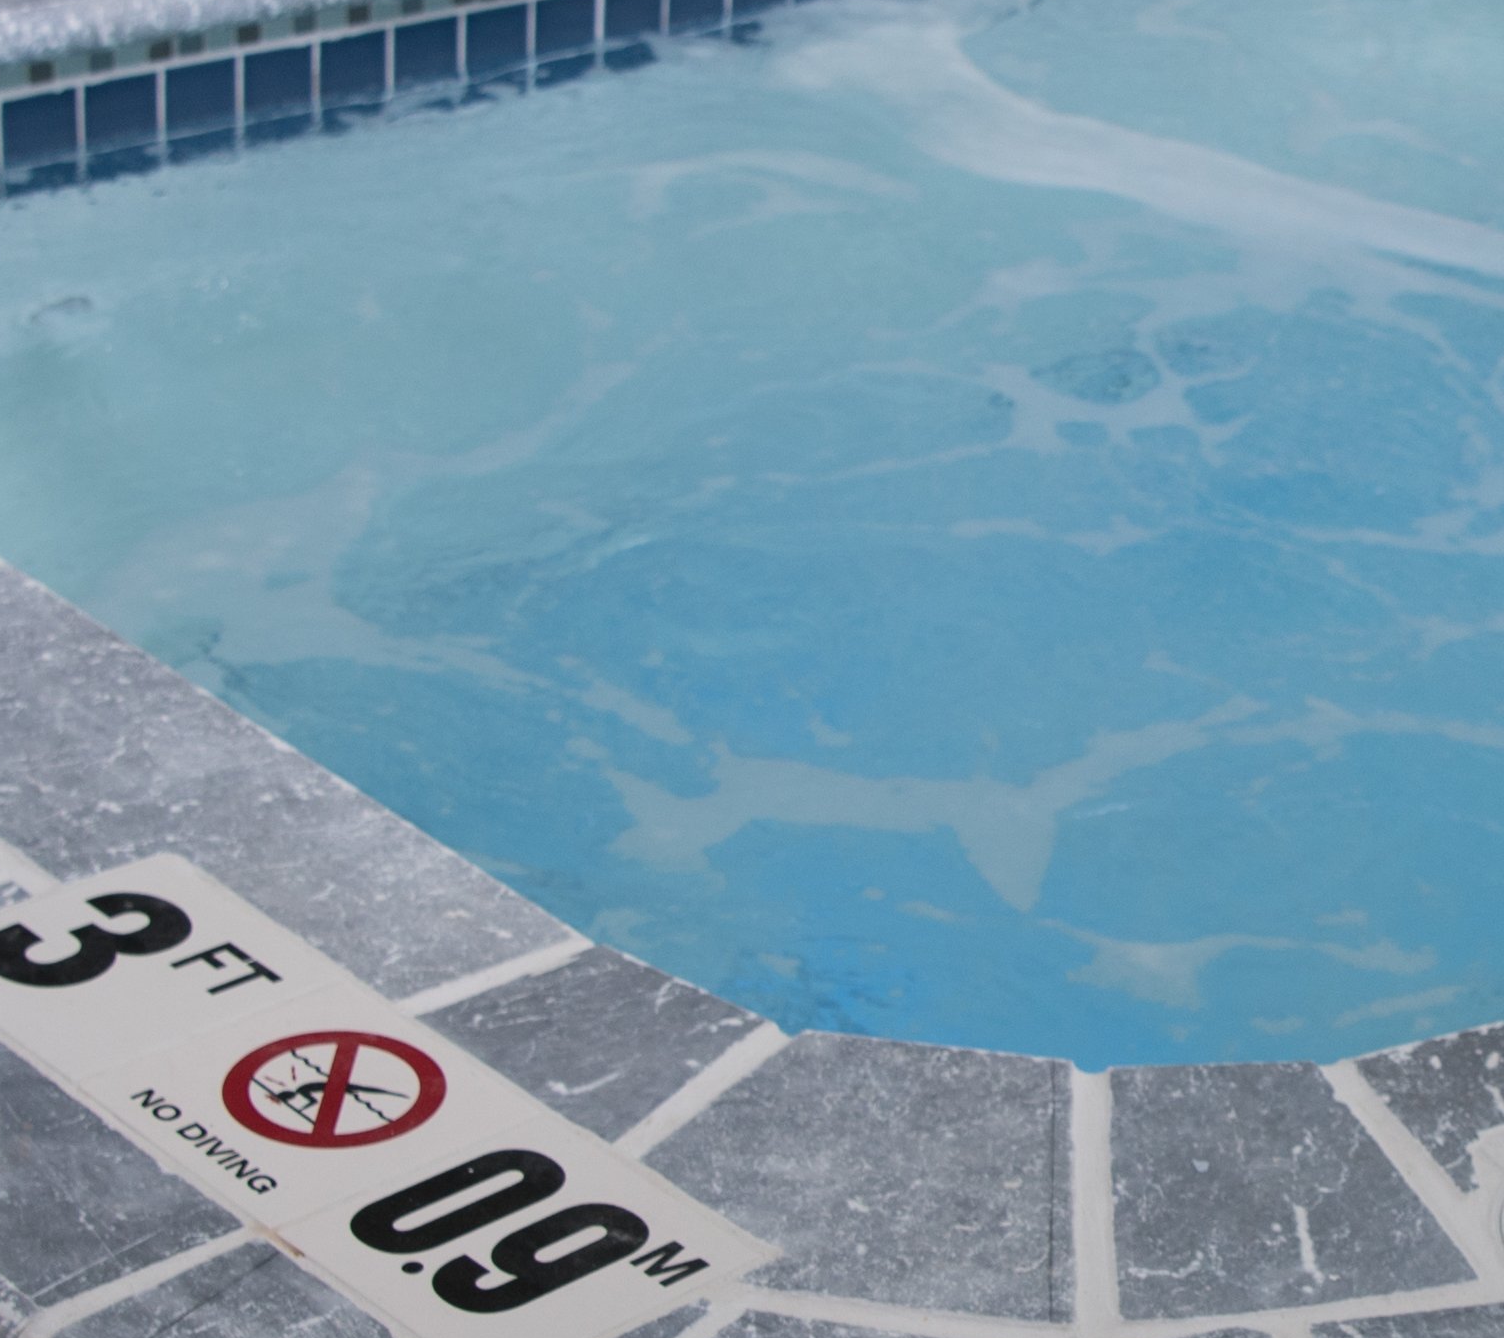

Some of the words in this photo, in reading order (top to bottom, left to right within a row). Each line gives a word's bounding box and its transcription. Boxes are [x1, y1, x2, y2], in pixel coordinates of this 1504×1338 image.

[171, 942, 282, 995] FT
[130, 1089, 183, 1121] NO
[176, 1122, 278, 1194] DIVING
[629, 1240, 710, 1288] M
